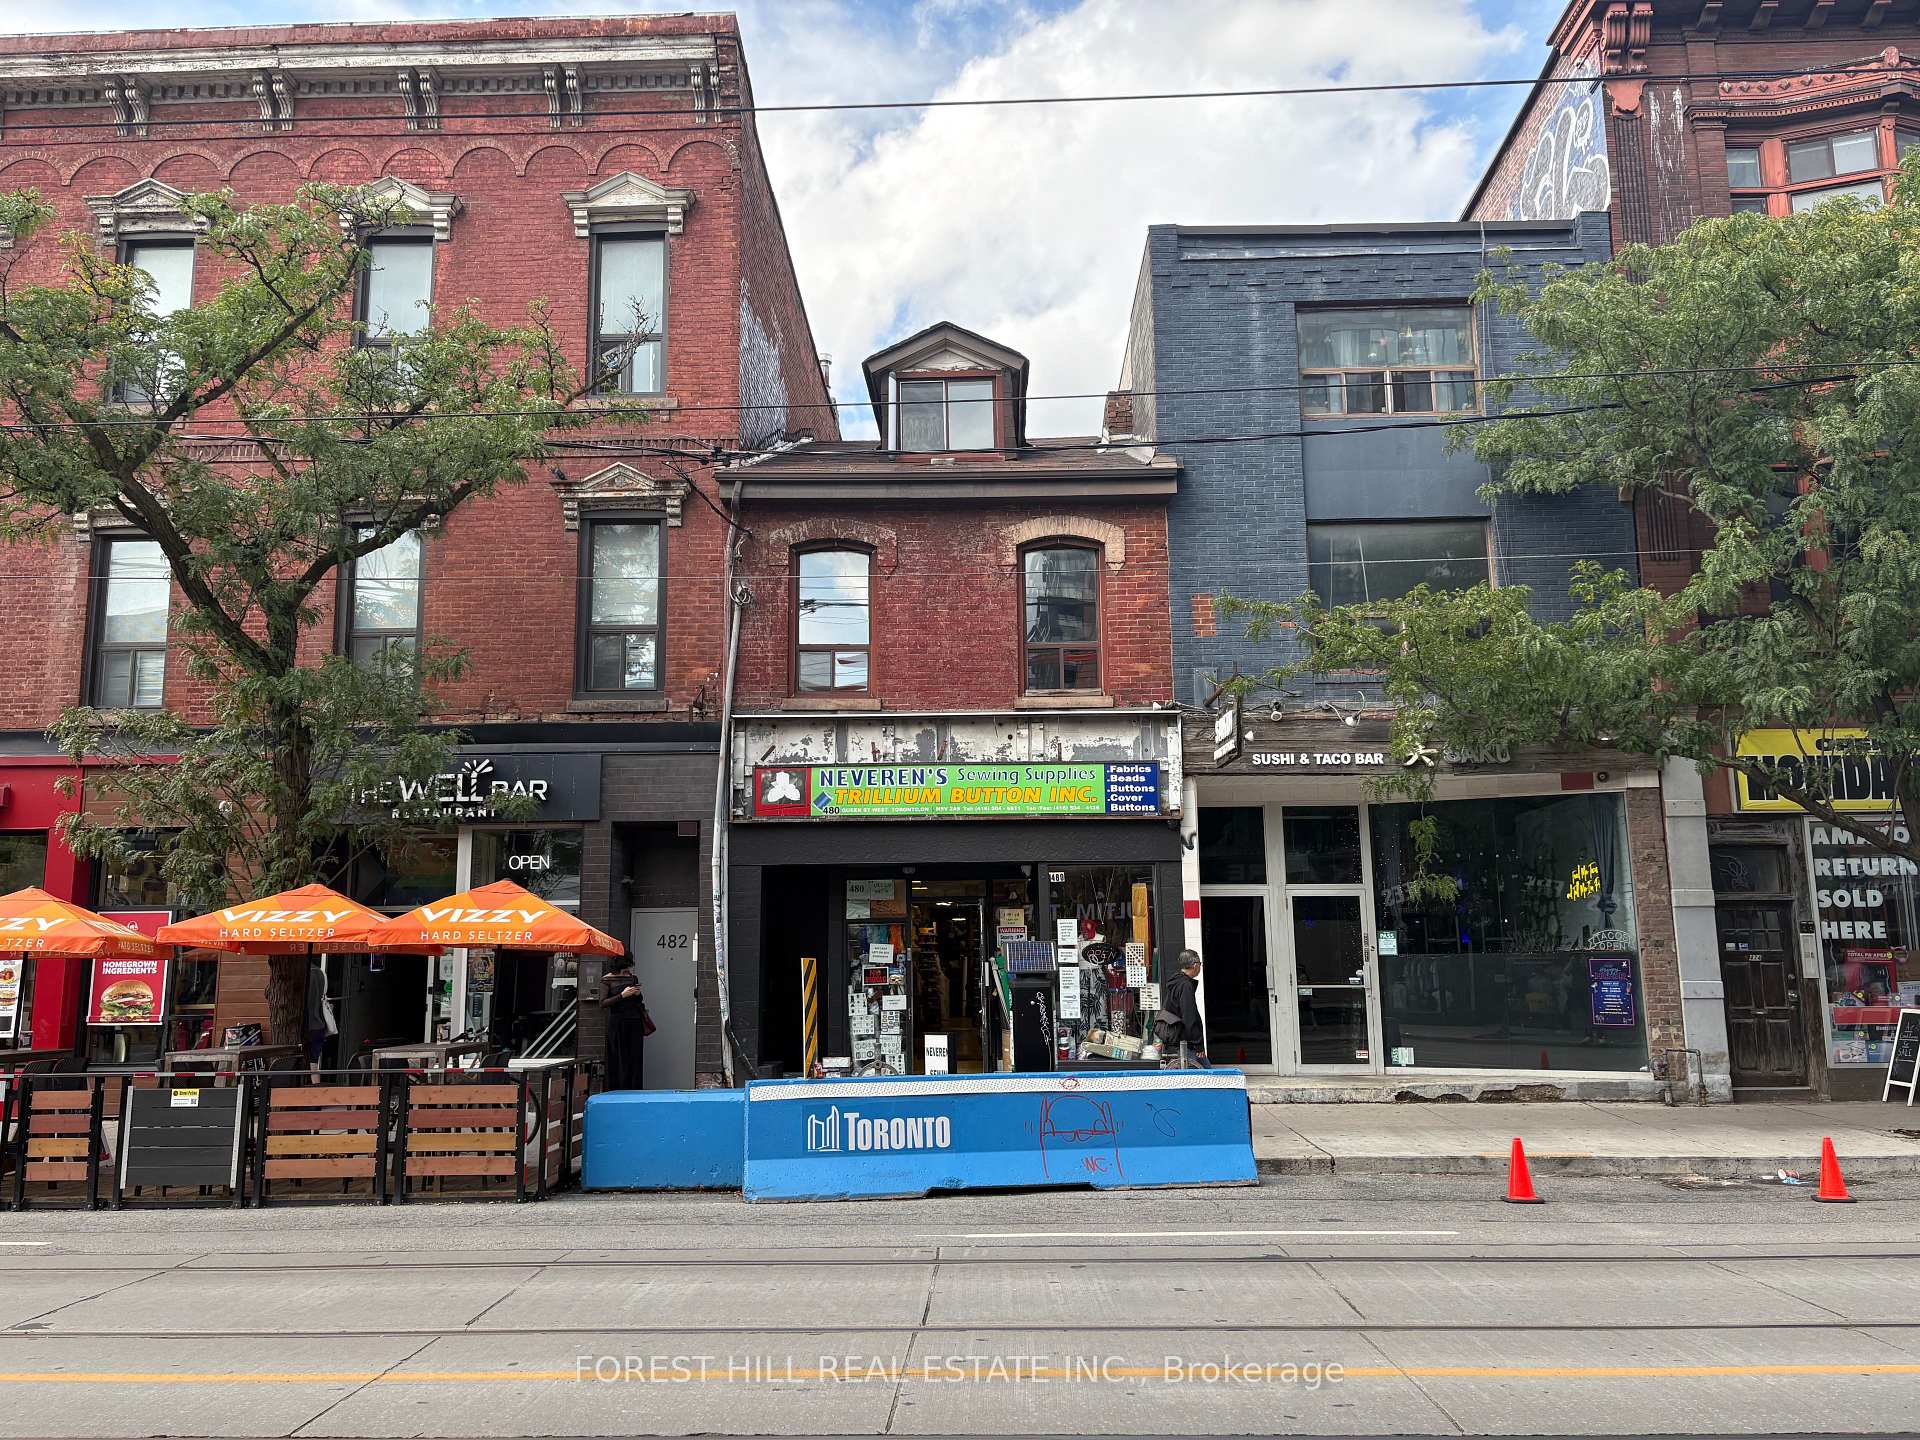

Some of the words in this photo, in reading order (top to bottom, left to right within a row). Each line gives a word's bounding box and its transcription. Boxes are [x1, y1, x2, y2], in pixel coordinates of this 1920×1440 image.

[1252, 753, 1295, 765] SUSHI
[1300, 753, 1310, 765] &
[1313, 753, 1351, 765] TACO
[1355, 753, 1384, 765] BAR
[820, 767, 949, 787] NEVEREN'S
[957, 767, 1020, 784] Sewing
[1025, 767, 1096, 784] Supplies
[835, 786, 942, 805] TRILLIUM
[950, 786, 1041, 804] BUTTON
[1050, 786, 1098, 803] INC.
[822, 806, 840, 814] 480
[1110, 803, 1156, 811] Buttons
[509, 855, 550, 870] OPEN
[1813, 857, 1919, 876] RETURN
[1817, 889, 1884, 908] SOLD
[220, 910, 353, 923] VIZZY
[420, 908, 548, 924] VIZZY
[0, 917, 66, 931] ZY
[1820, 920, 1888, 939] HERE
[220, 927, 263, 938] HARD
[270, 927, 336, 938] SELTZER
[420, 930, 462, 941] HARD
[468, 930, 533, 941] SELTZER
[0, 938, 45, 948] TZER
[656, 934, 688, 949] 482
[1599, 941, 1627, 950] OPEN
[102, 960, 158, 968] HOMEGROWN
[843, 1112, 951, 1151] TORONTO
